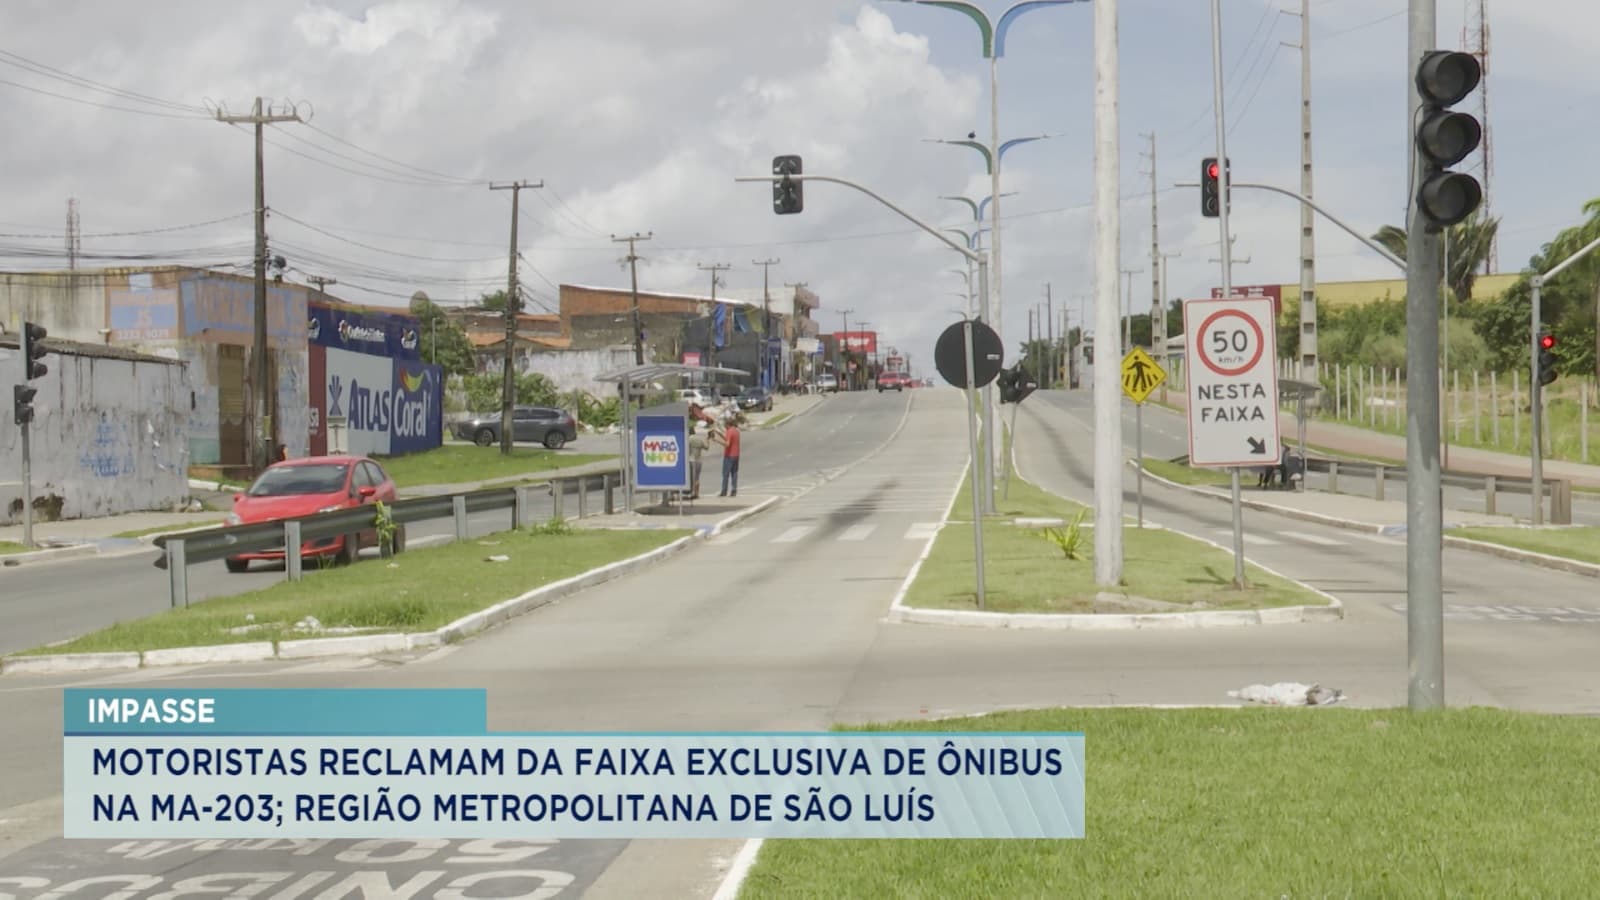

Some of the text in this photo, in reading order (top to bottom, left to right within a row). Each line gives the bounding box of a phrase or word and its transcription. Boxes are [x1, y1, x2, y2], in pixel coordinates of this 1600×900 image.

[1213, 330, 1248, 353] 50
[1218, 356, 1245, 364] km/h
[1198, 383, 1267, 401] NESTA
[348, 379, 390, 432] ATLAS
[394, 388, 427, 438] Coral
[1202, 406, 1264, 423] FAIXA
